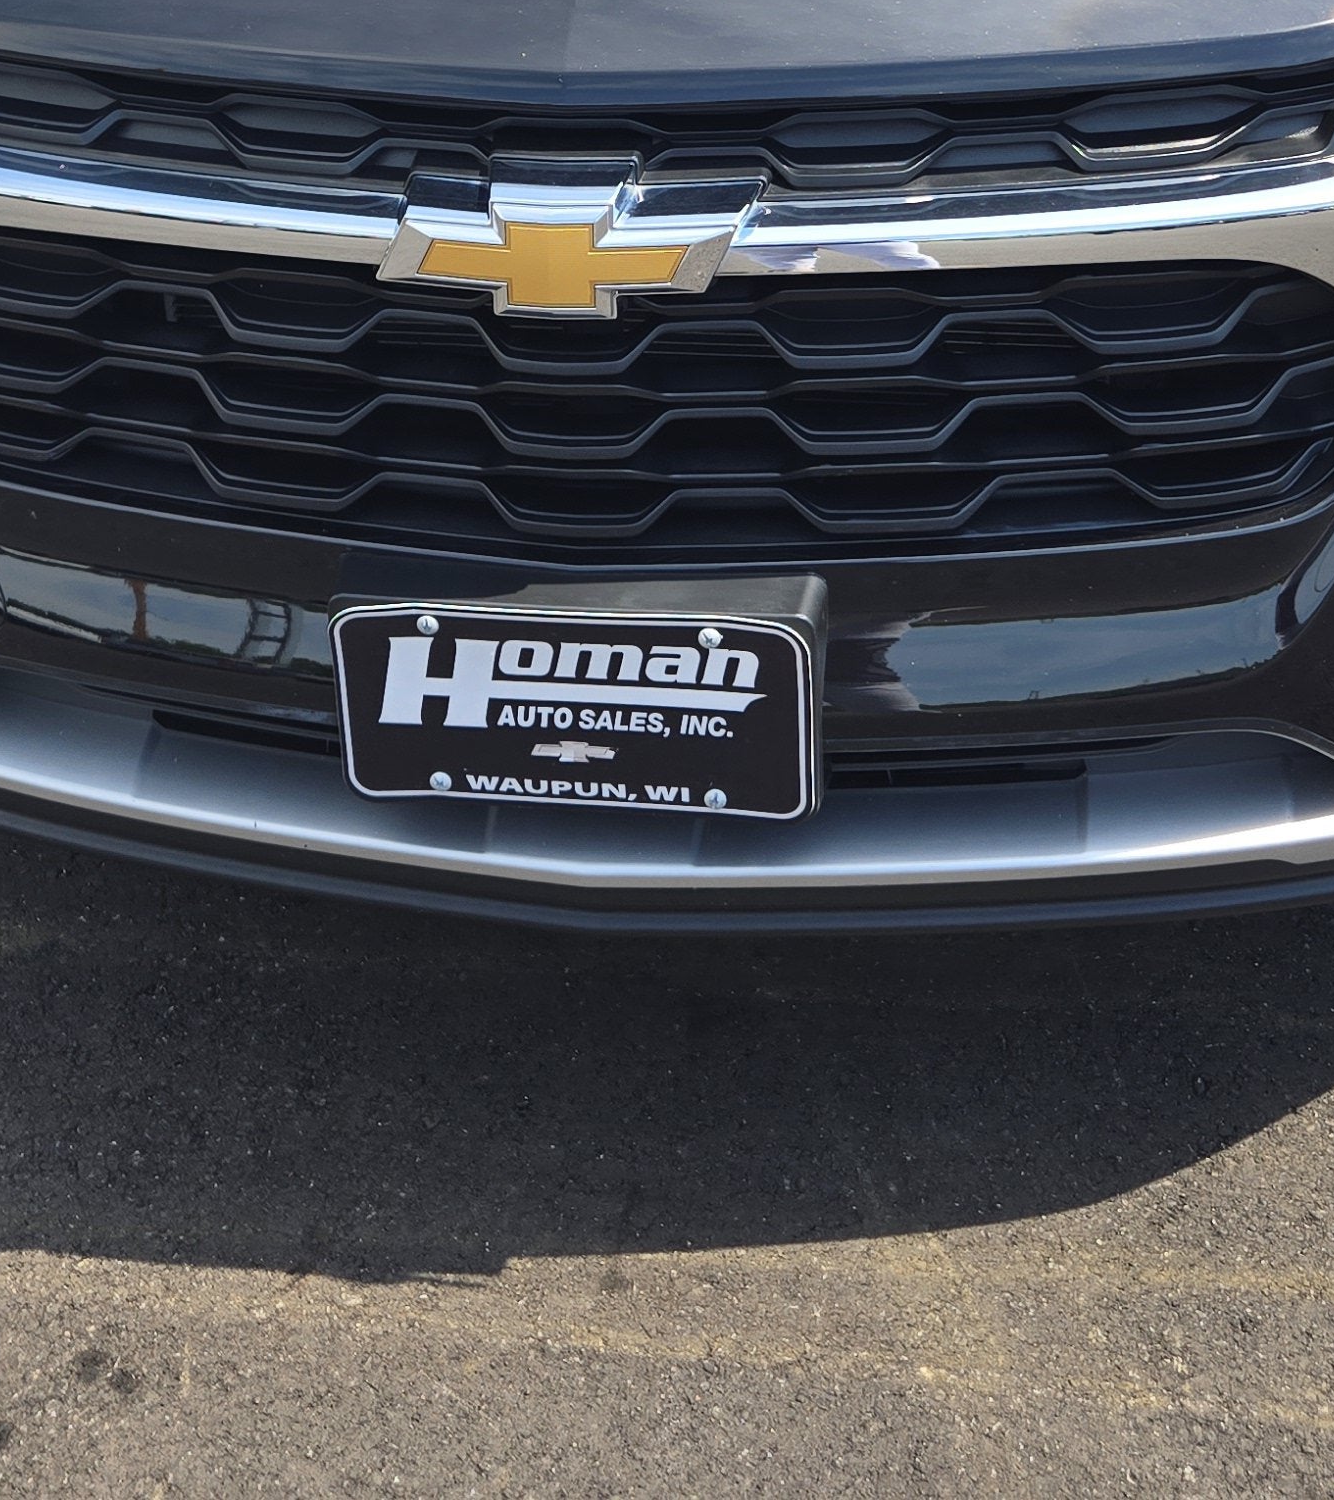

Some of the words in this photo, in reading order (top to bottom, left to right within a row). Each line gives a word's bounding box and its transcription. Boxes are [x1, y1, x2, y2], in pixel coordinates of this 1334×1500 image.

[378, 636, 767, 729] Homan
[497, 705, 574, 730] AUTO
[578, 709, 670, 738] SALES,
[679, 714, 734, 739] INC.
[465, 773, 638, 802] WAUPUN,
[644, 784, 690, 803] WI
